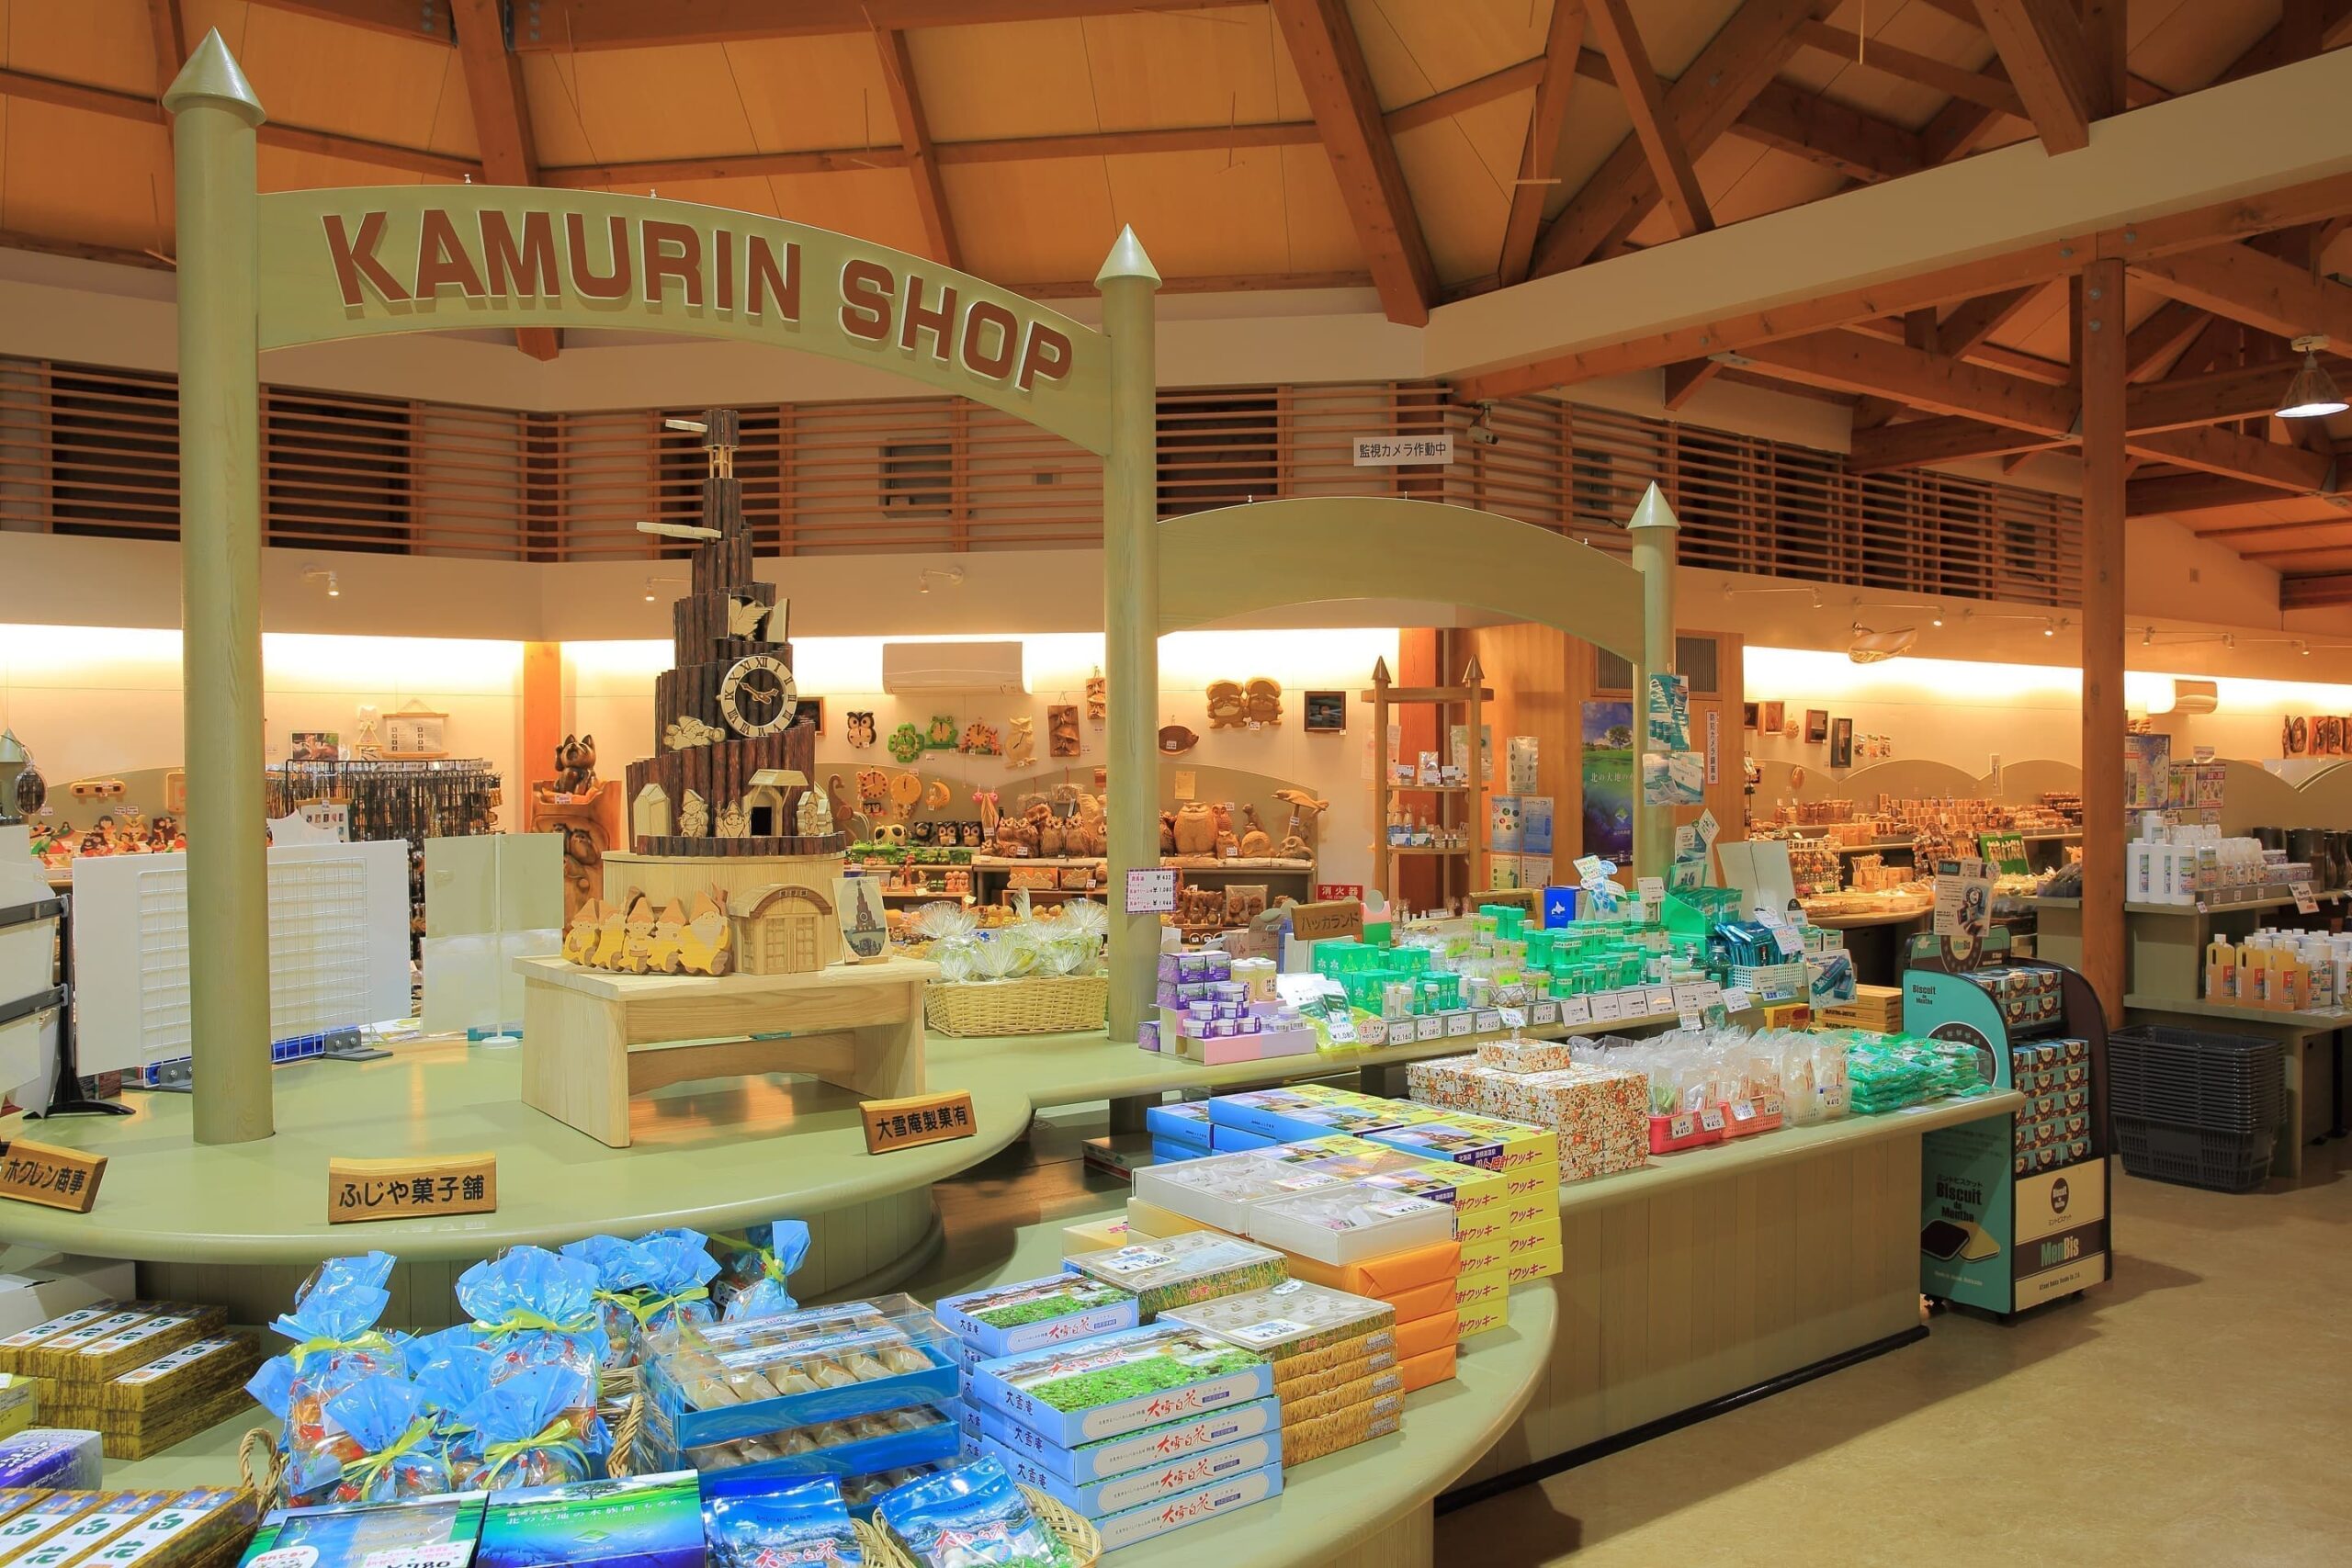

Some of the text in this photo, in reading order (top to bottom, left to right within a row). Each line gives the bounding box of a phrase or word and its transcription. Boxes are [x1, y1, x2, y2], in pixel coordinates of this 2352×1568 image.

[321, 209, 1073, 392] KAMURIN SHOP
[1359, 442, 1446, 458] 監視カメラ作動中
[1321, 886, 1359, 897] 消火器
[1300, 911, 1360, 932] ハッカランド
[1912, 984, 1937, 995] Biscuit
[3, 1157, 87, 1196] ホクレン商事
[1508, 1179, 1544, 1195] クッキー
[339, 1174, 485, 1208] ふじや菓子舗
[1936, 1181, 1983, 1206] Biscuit
[1510, 1207, 1544, 1224] クッキー
[1941, 1206, 1975, 1223] Menthe
[1510, 1235, 1545, 1253] クッキー
[2041, 1235, 2080, 1267] MenBis
[959, 1319, 980, 1336] 大雪庵
[1047, 1316, 1095, 1342] 大雪白花
[1005, 1390, 1034, 1416] 大雪庵
[1145, 1388, 1203, 1422] 大雪白花
[1014, 1425, 1045, 1453] 大雪庵
[1154, 1424, 1212, 1458] 大雪白花
[1017, 1461, 1047, 1490] 大雪庵
[1158, 1458, 1214, 1493] 大雪白花
[506, 1505, 635, 1526] 北の大地の水族館
[645, 1499, 682, 1509] もなか
[1159, 1493, 1216, 1529] 大雪白花
